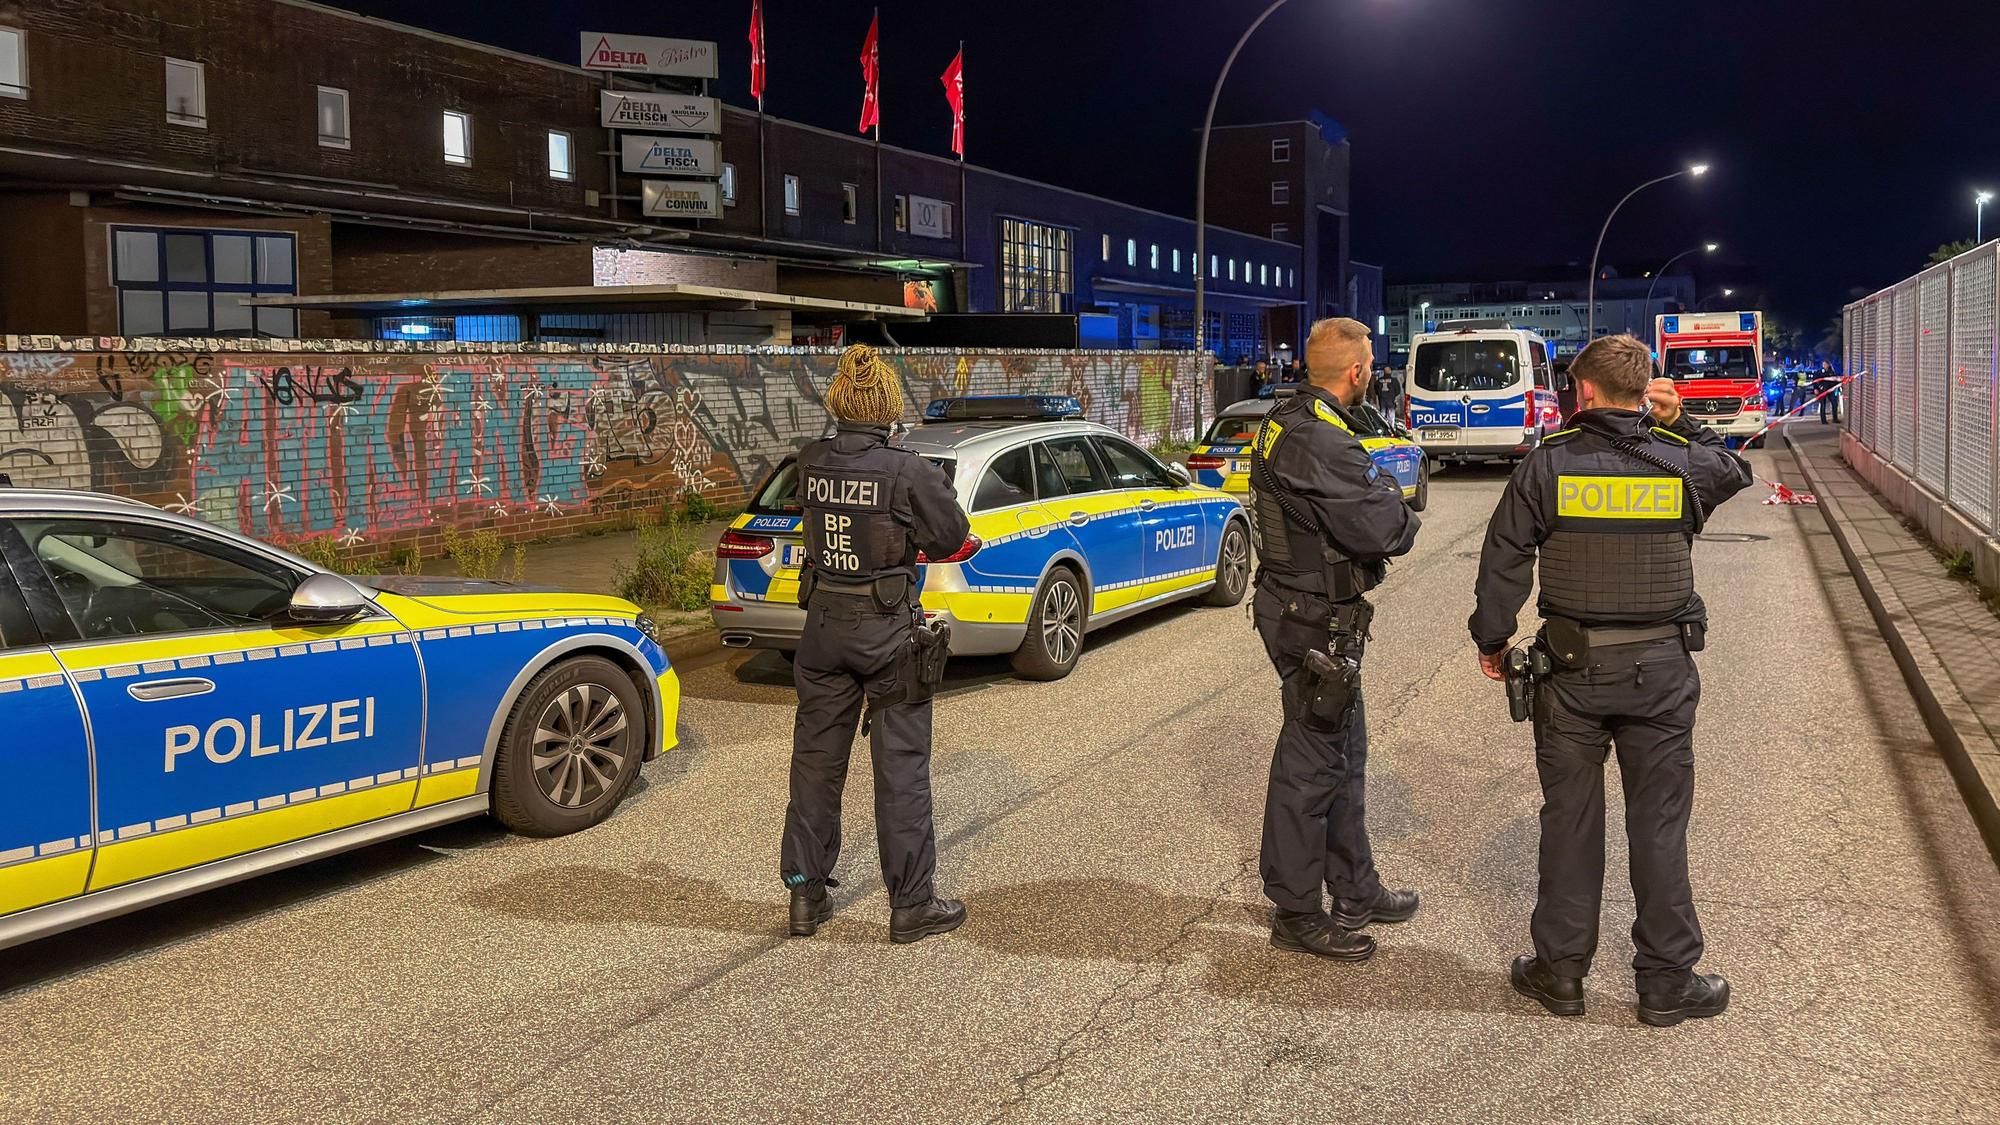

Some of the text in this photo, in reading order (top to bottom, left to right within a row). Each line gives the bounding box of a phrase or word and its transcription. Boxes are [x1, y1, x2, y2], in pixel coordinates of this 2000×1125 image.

[599, 51, 648, 65] DELTA
[622, 102, 661, 113] DELTA
[620, 111, 667, 122] FLEISCH
[654, 147, 692, 158] DELTA
[664, 191, 700, 200] DELTA
[666, 200, 708, 210] CONVIN
[1416, 413, 1460, 424] POLIZEI
[807, 476, 879, 506] POLIZEI
[1561, 482, 1679, 512] POLIZEI
[753, 518, 791, 528] POLIZEI
[824, 513, 852, 533] BP
[825, 532, 852, 552] UE
[1155, 524, 1195, 552] POLIZEI
[822, 549, 860, 571] 3110
[164, 696, 375, 772] POLIZEI
